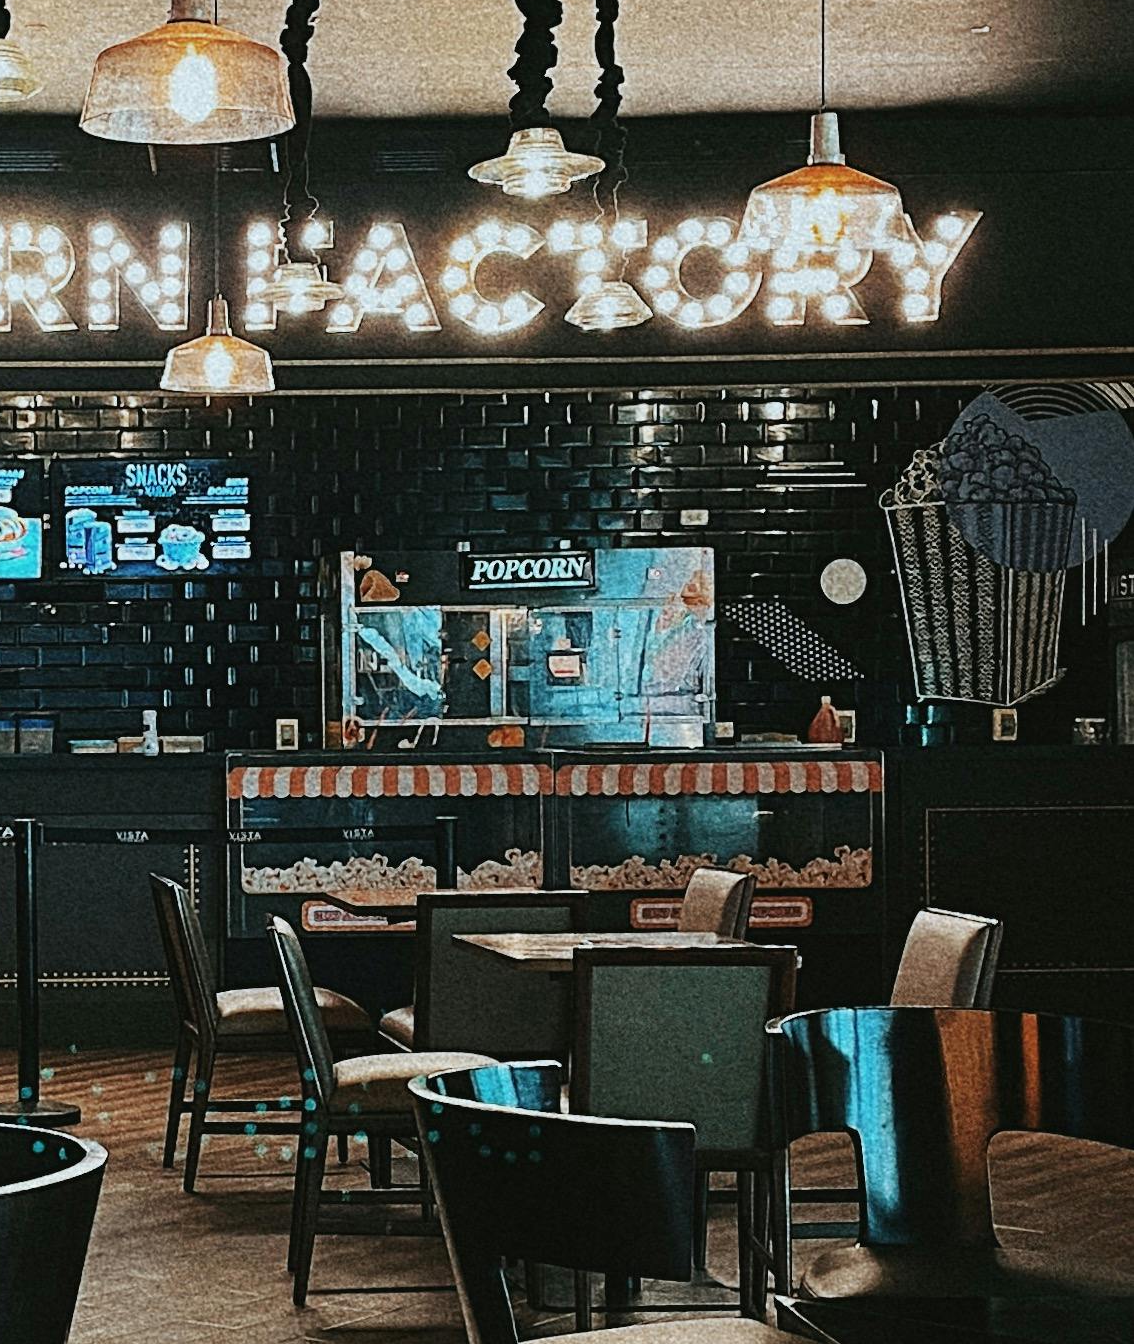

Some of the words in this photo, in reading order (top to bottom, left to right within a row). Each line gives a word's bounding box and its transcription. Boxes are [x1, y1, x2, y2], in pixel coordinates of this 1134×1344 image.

[244, 210, 985, 333] FACTORY
[125, 464, 188, 487] SNACKS
[471, 556, 587, 581] POPCORN
[115, 830, 150, 840] VISTA
[229, 830, 262, 840] VISTA
[341, 828, 375, 839] VISTA
